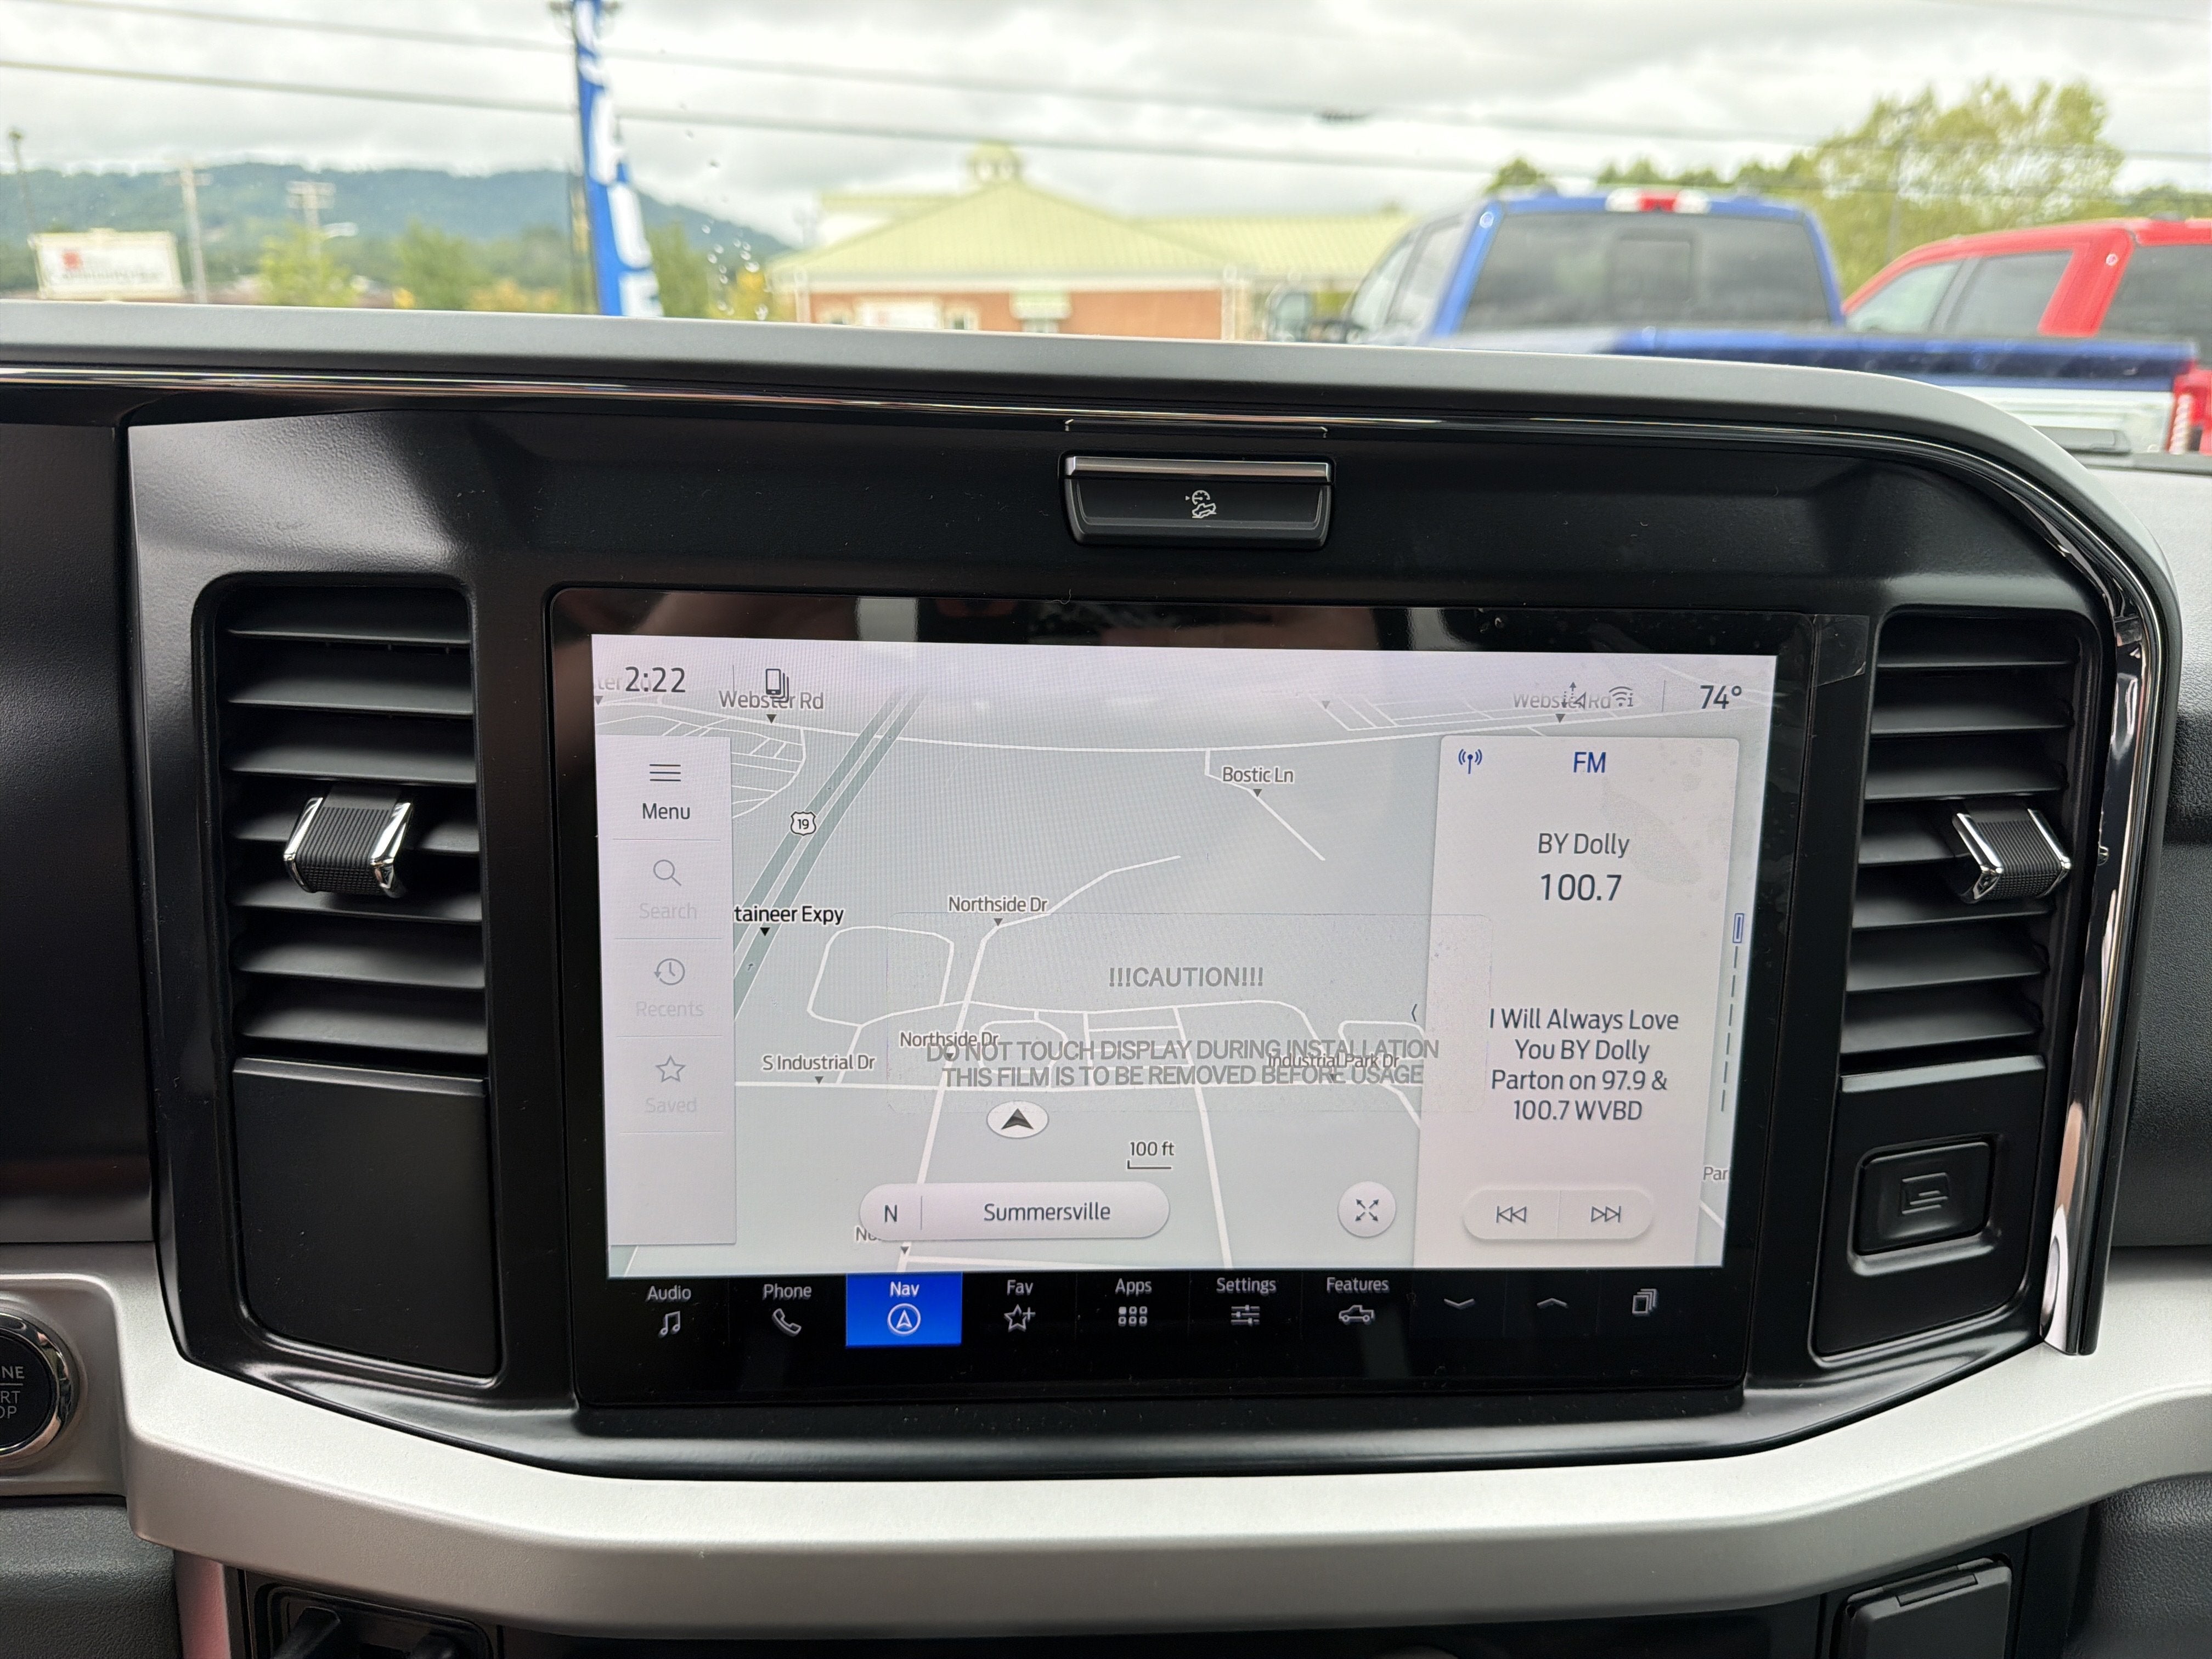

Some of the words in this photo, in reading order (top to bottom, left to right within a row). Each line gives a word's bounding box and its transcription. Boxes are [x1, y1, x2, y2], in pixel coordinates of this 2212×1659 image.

[625, 665, 686, 693] 2:22
[799, 691, 824, 710] Rd
[1573, 751, 1606, 774] FM
[1222, 766, 1271, 783] Bostic
[1274, 767, 1294, 783] Ln
[642, 803, 691, 820] Menu
[797, 818, 810, 830] 19
[1537, 832, 1569, 854] BY
[1573, 833, 1630, 859] Dolly
[1540, 873, 1623, 901] 100.7
[639, 902, 697, 920] Search
[948, 896, 1026, 912] Northside
[1030, 897, 1048, 912] Dr
[802, 905, 844, 926] Expy
[1109, 967, 1263, 988] !!!CAUTION!!!
[636, 1001, 704, 1017] Recents
[1489, 1008, 1494, 1029] I
[1500, 1008, 1541, 1029] Will
[1546, 1008, 1623, 1034] Always
[1629, 1009, 1679, 1030] Love
[900, 1031, 978, 1047] Northside
[981, 1031, 999, 1047] Dr
[927, 1041, 960, 1062] DO
[964, 1041, 1013, 1062] NOT
[1016, 1040, 1094, 1061] TOUCH
[1101, 1040, 1192, 1060] DISPLAY
[1197, 1039, 1282, 1059] DURING
[1287, 1039, 1440, 1059] INSTALLATION
[1514, 1039, 1555, 1060] You
[1560, 1039, 1591, 1060] BY
[1595, 1039, 1650, 1064] Dolly
[763, 1054, 773, 1070] S
[778, 1054, 854, 1070] Industrial
[857, 1055, 876, 1070] Dr
[1268, 1053, 1340, 1068] Industrial
[1344, 1053, 1379, 1068] Park
[1383, 1053, 1400, 1068] Dr
[942, 1067, 993, 1087] THIS
[997, 1066, 1049, 1087] FILM
[1056, 1066, 1075, 1086] IS
[1079, 1065, 1110, 1086] TO
[1115, 1065, 1144, 1085] BE
[1148, 1065, 1256, 1085] REMOVED
[1261, 1064, 1346, 1084] BEFORE
[1351, 1064, 1424, 1084] USAGE
[1491, 1069, 1564, 1090] Parton
[1568, 1074, 1596, 1090] on
[1601, 1070, 1646, 1091] 97.9
[1651, 1070, 1668, 1091] &
[644, 1097, 697, 1114] Saved
[1513, 1099, 1570, 1121] 100.7
[1574, 1100, 1643, 1121] WVBD
[1129, 1141, 1158, 1156] 100
[1161, 1141, 1175, 1156] ft
[1703, 1166, 1729, 1181] Par
[884, 1204, 898, 1222] N
[983, 1201, 1111, 1221] Summersville
[646, 1285, 692, 1301] Audio
[763, 1283, 812, 1300] Phone
[889, 1281, 920, 1297] Nav
[1006, 1279, 1034, 1295] Fav
[1115, 1278, 1153, 1295] Apps
[1216, 1277, 1277, 1295] Settings
[1326, 1276, 1390, 1293] Features
